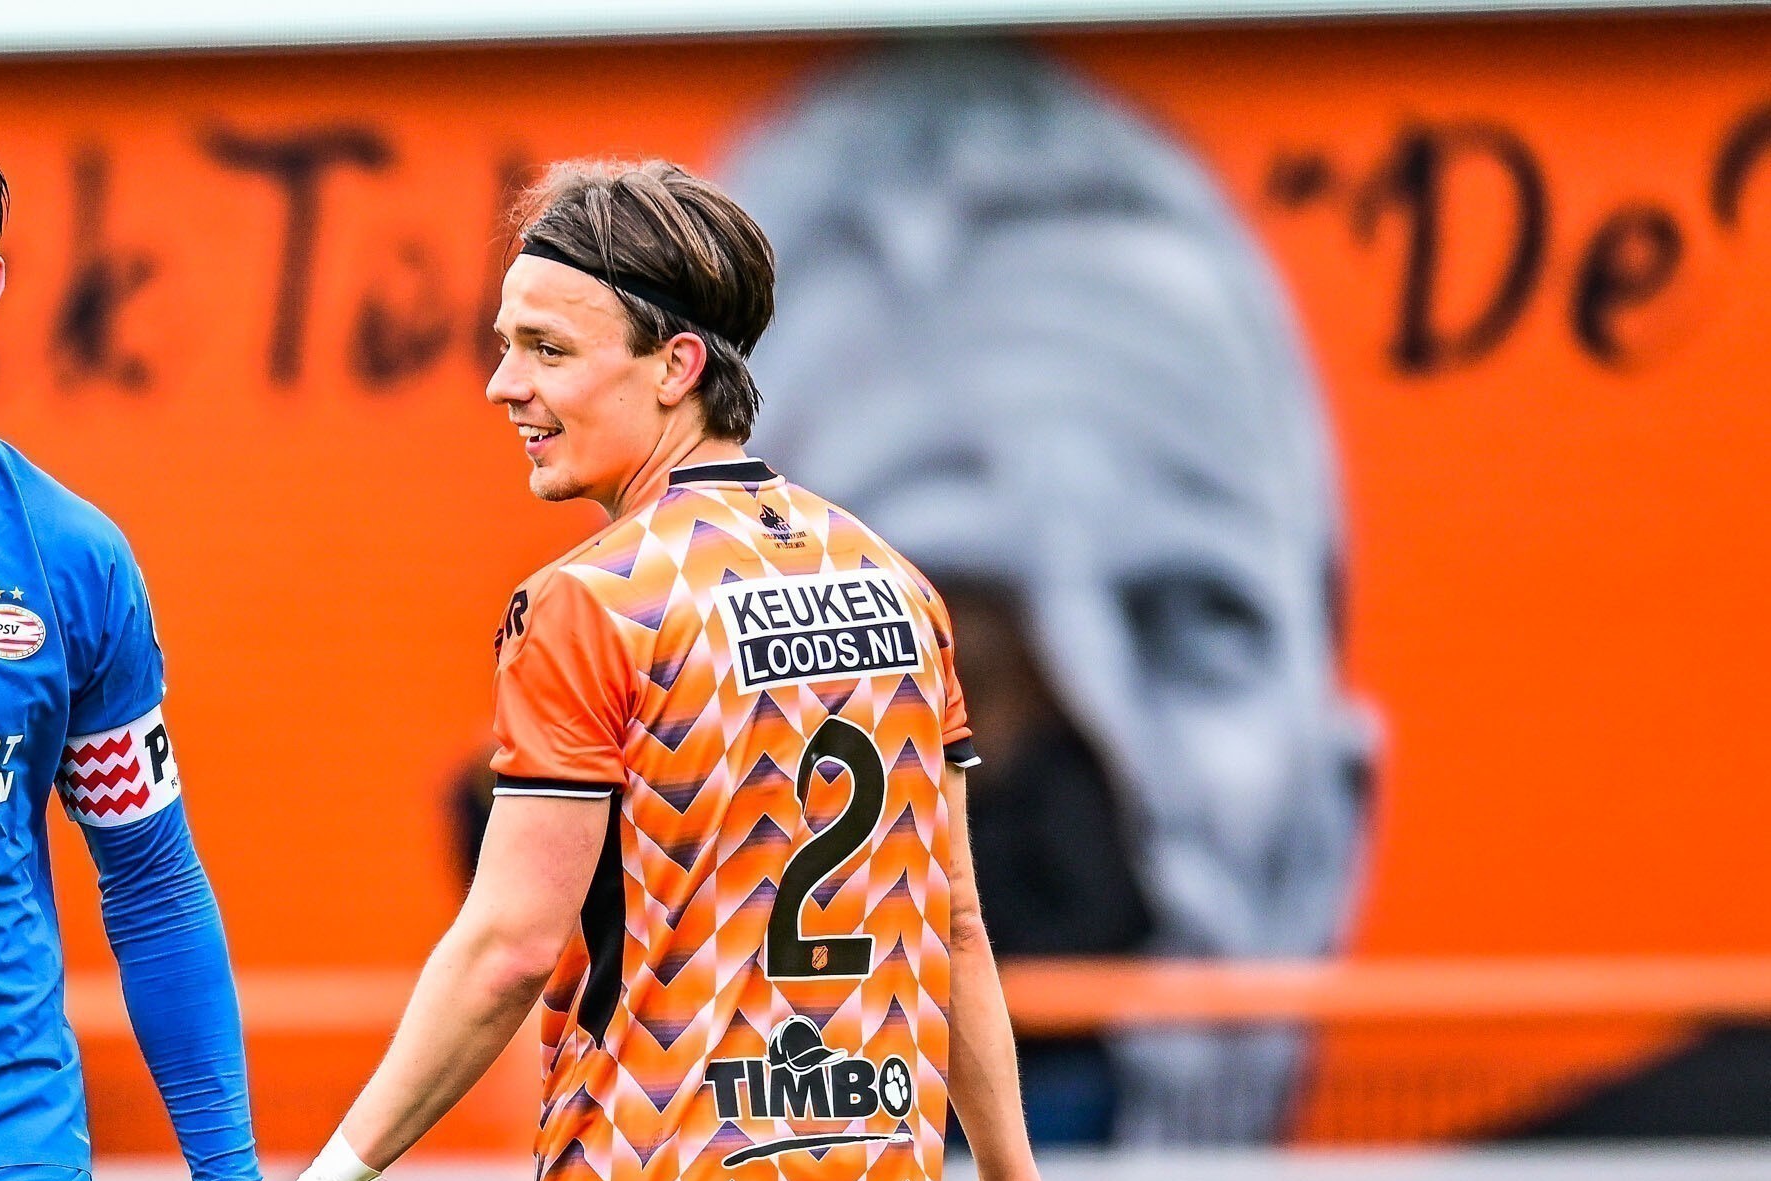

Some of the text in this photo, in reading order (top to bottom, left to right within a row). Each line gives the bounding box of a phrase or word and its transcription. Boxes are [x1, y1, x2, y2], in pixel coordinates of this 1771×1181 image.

[728, 579, 904, 635] KEUKEN
[743, 626, 916, 681] LOODS.NL
[766, 715, 887, 979] 2
[703, 1056, 913, 1119] TIMBO
